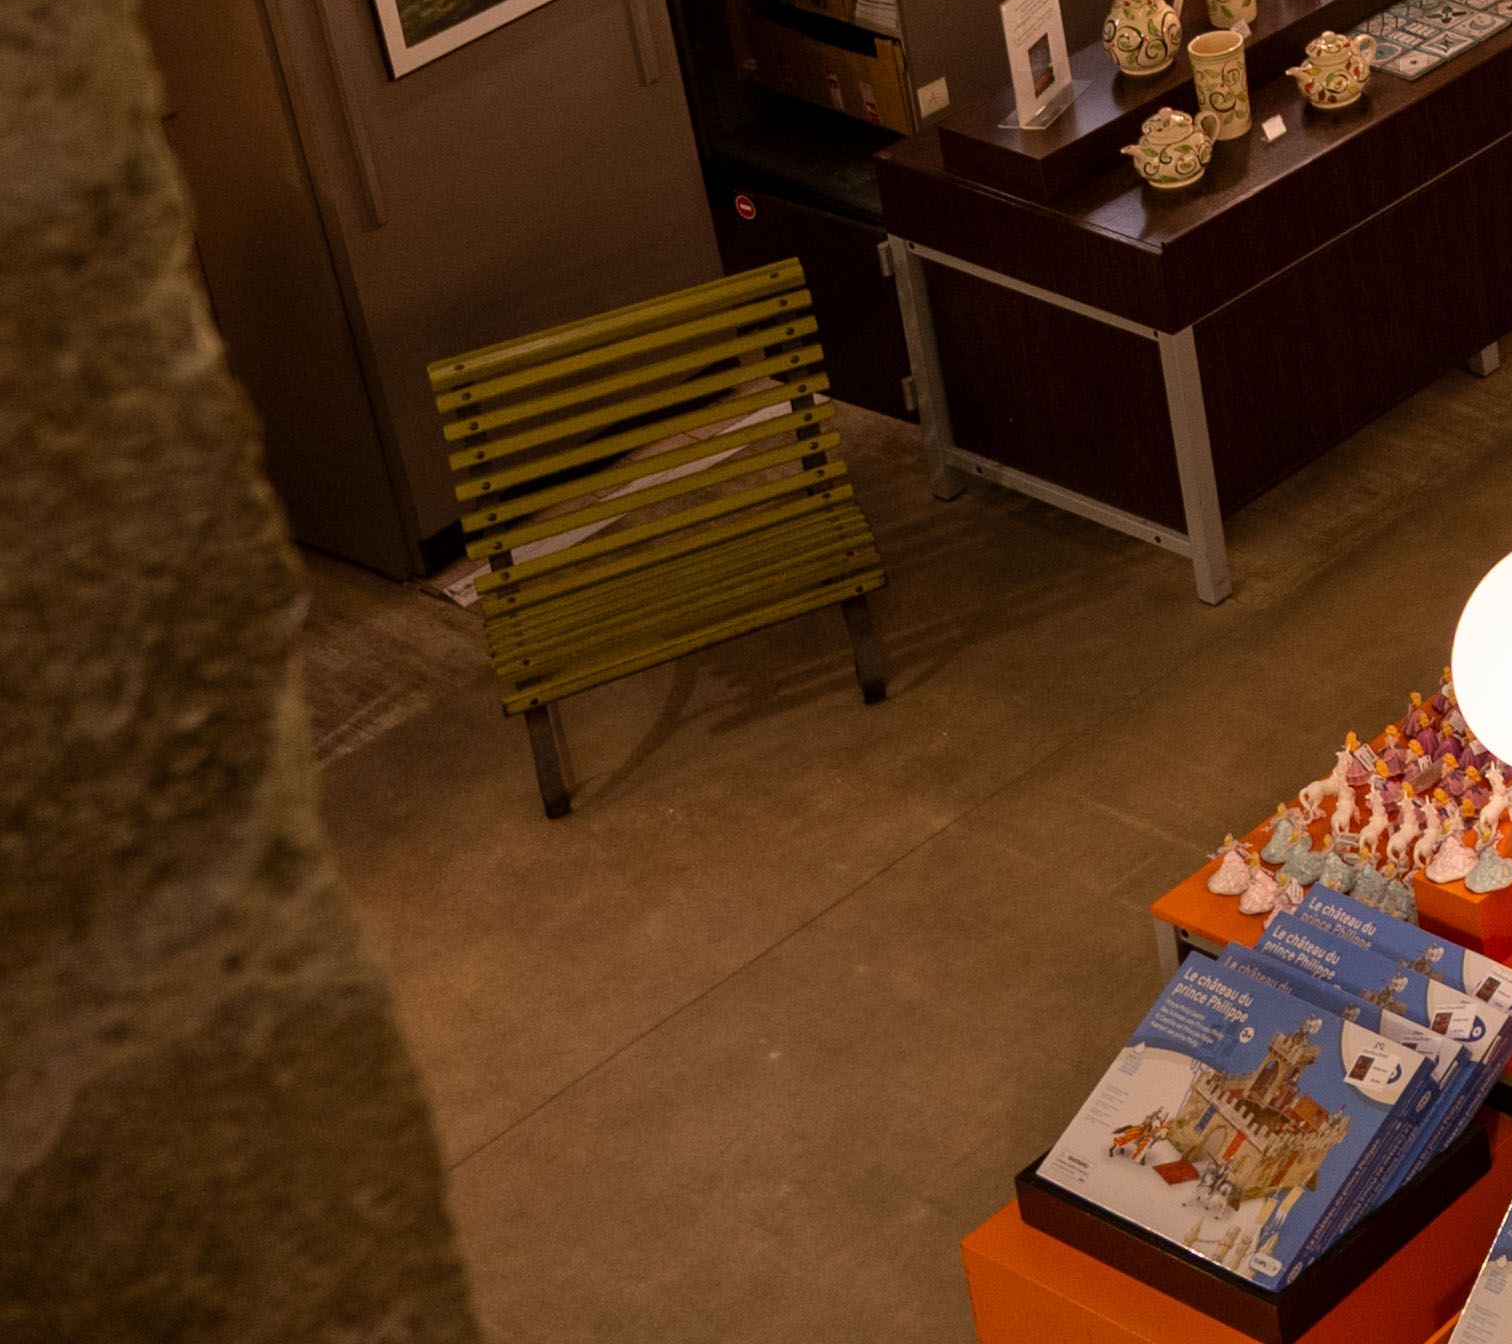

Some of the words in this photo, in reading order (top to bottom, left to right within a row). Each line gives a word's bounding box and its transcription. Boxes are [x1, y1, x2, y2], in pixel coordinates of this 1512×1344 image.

[1300, 913, 1332, 933] prince
[1308, 896, 1322, 911] Le
[1321, 902, 1361, 931] château
[1362, 922, 1377, 937] du
[1261, 940, 1293, 961] prince
[1294, 951, 1337, 981] Philippe
[1271, 925, 1286, 940] Le
[1285, 931, 1324, 959] château
[1325, 949, 1342, 965] du
[1182, 966, 1198, 982] Le
[1197, 972, 1238, 1003] château
[1238, 992, 1255, 1009] du
[1225, 955, 1241, 971] Le
[1241, 961, 1278, 989] château
[1172, 980, 1207, 1004] prince
[1206, 992, 1250, 1025] Philippe
